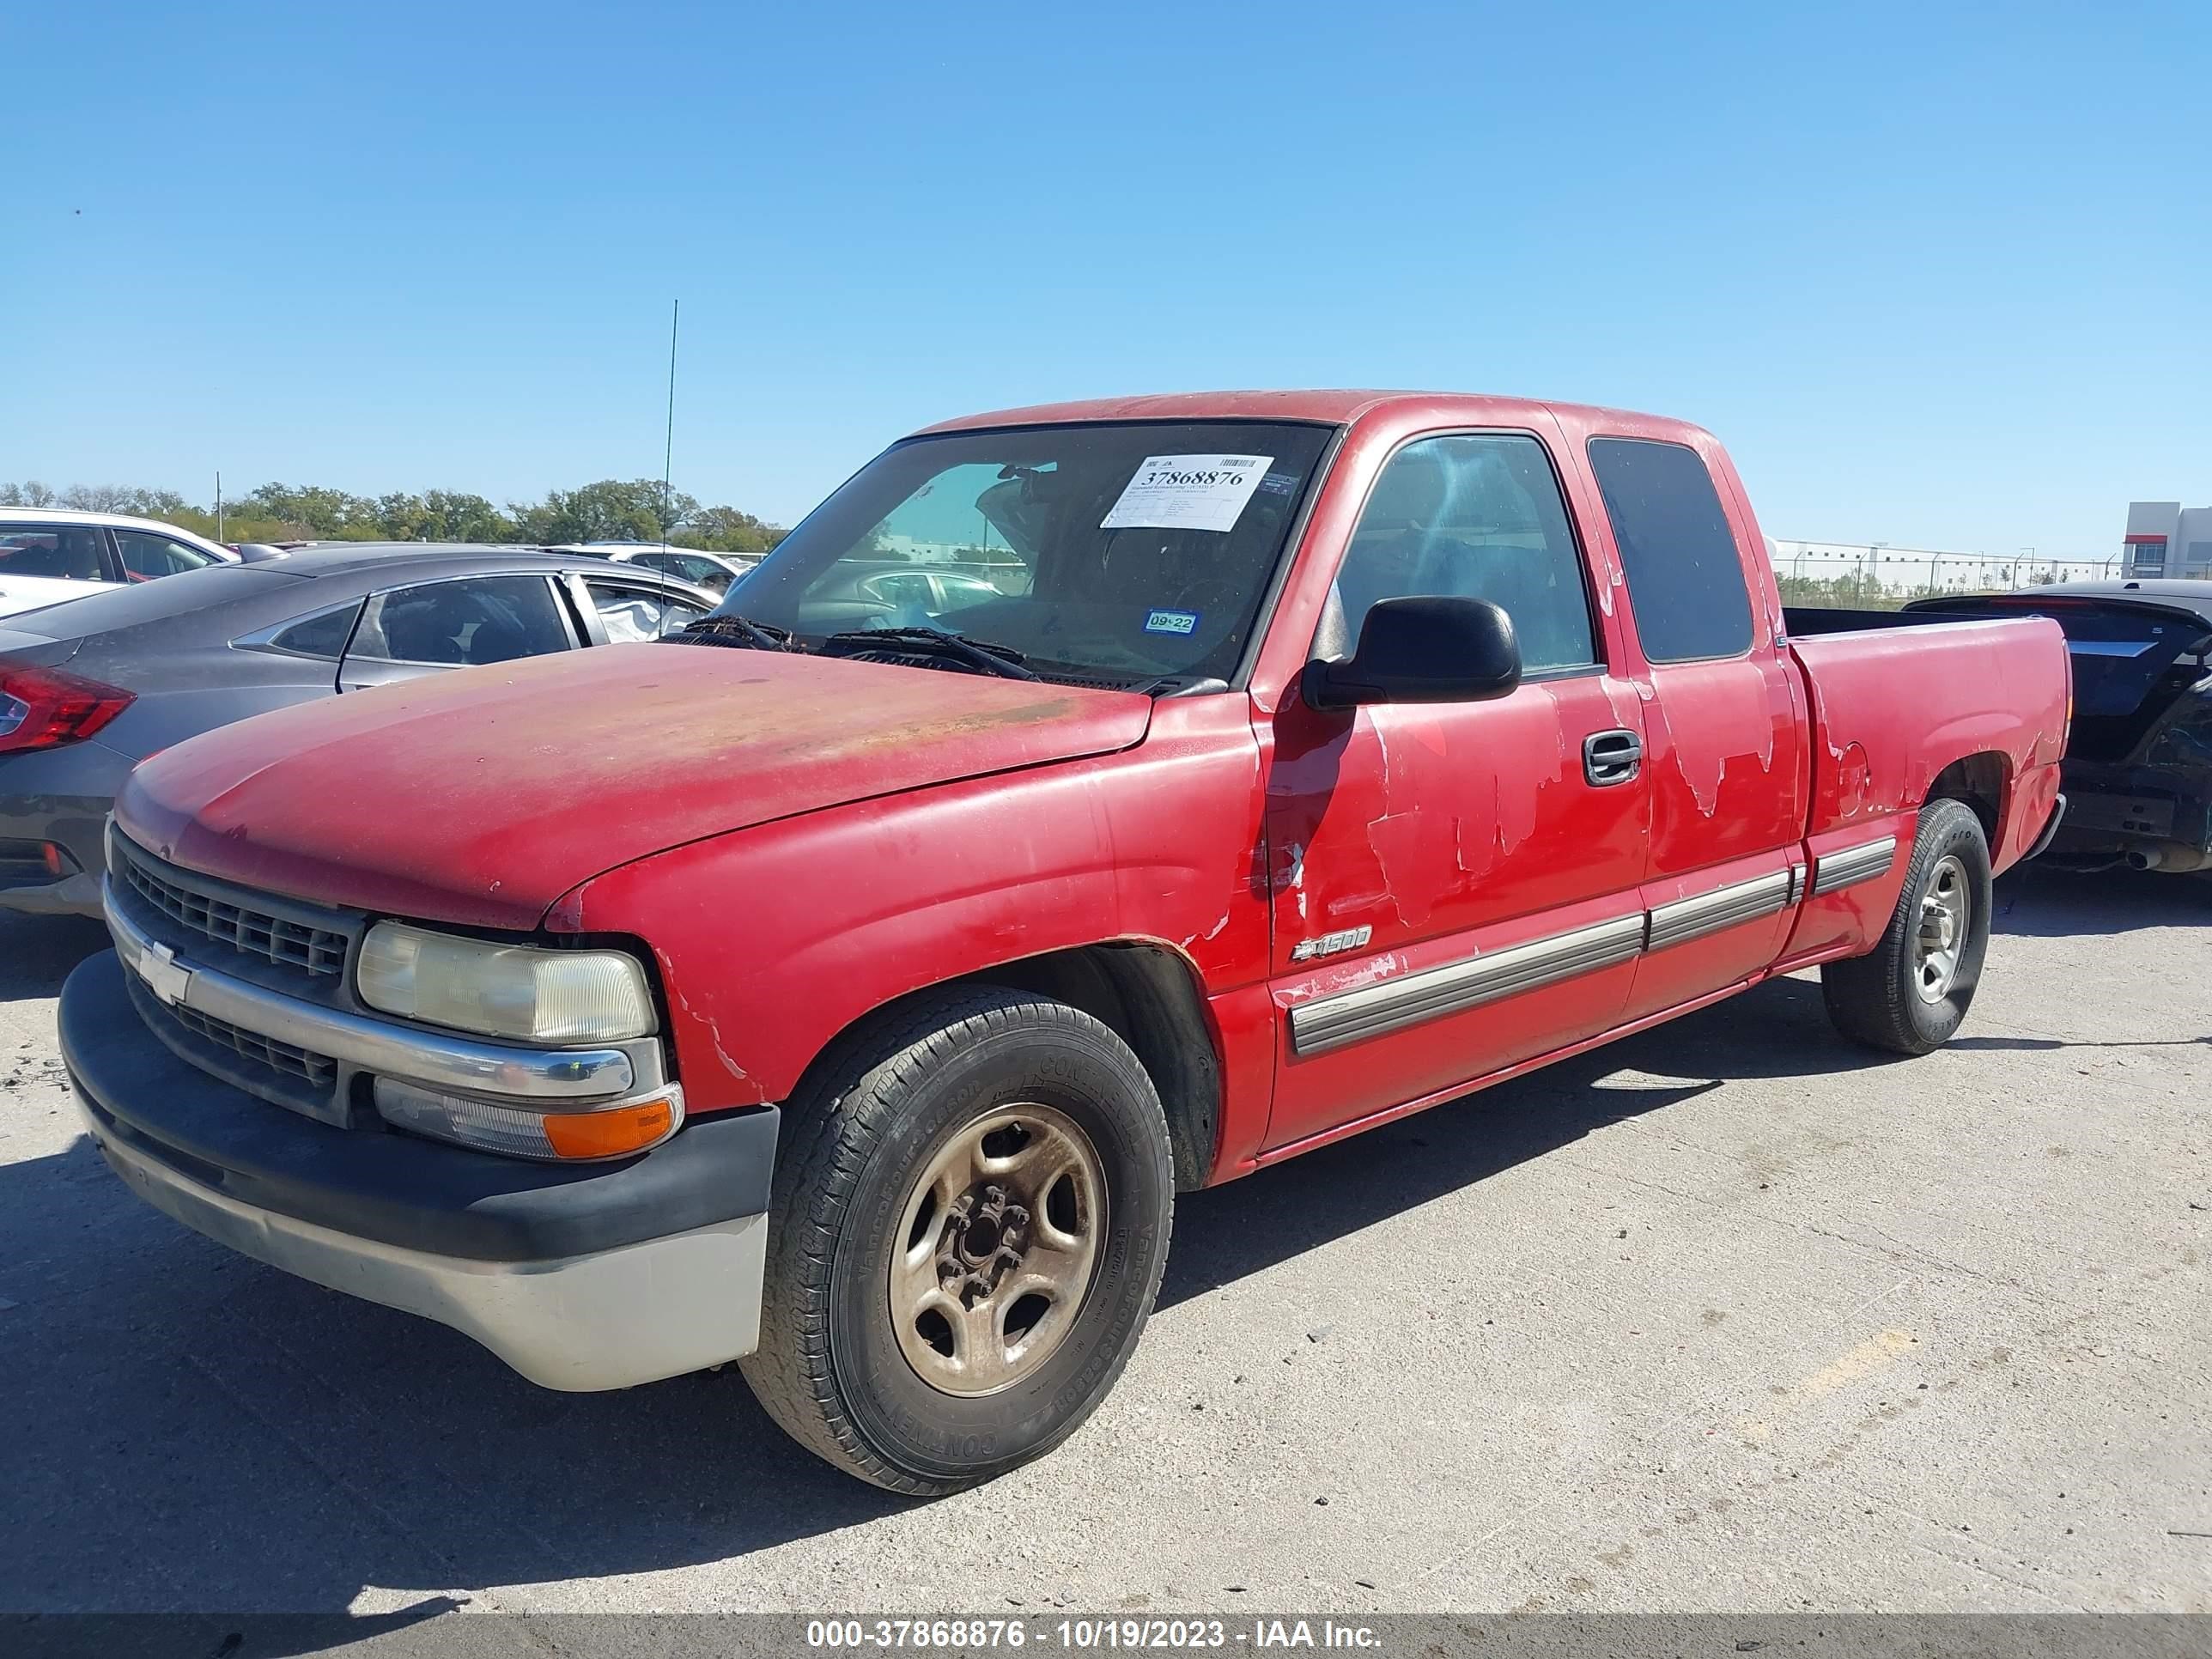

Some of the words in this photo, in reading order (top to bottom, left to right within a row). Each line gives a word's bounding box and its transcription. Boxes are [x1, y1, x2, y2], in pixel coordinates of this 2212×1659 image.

[1141, 470, 1248, 486] 37868876
[1150, 616, 1168, 626] 09
[1173, 617, 1192, 628] 22
[1321, 924, 1372, 954] 1500
